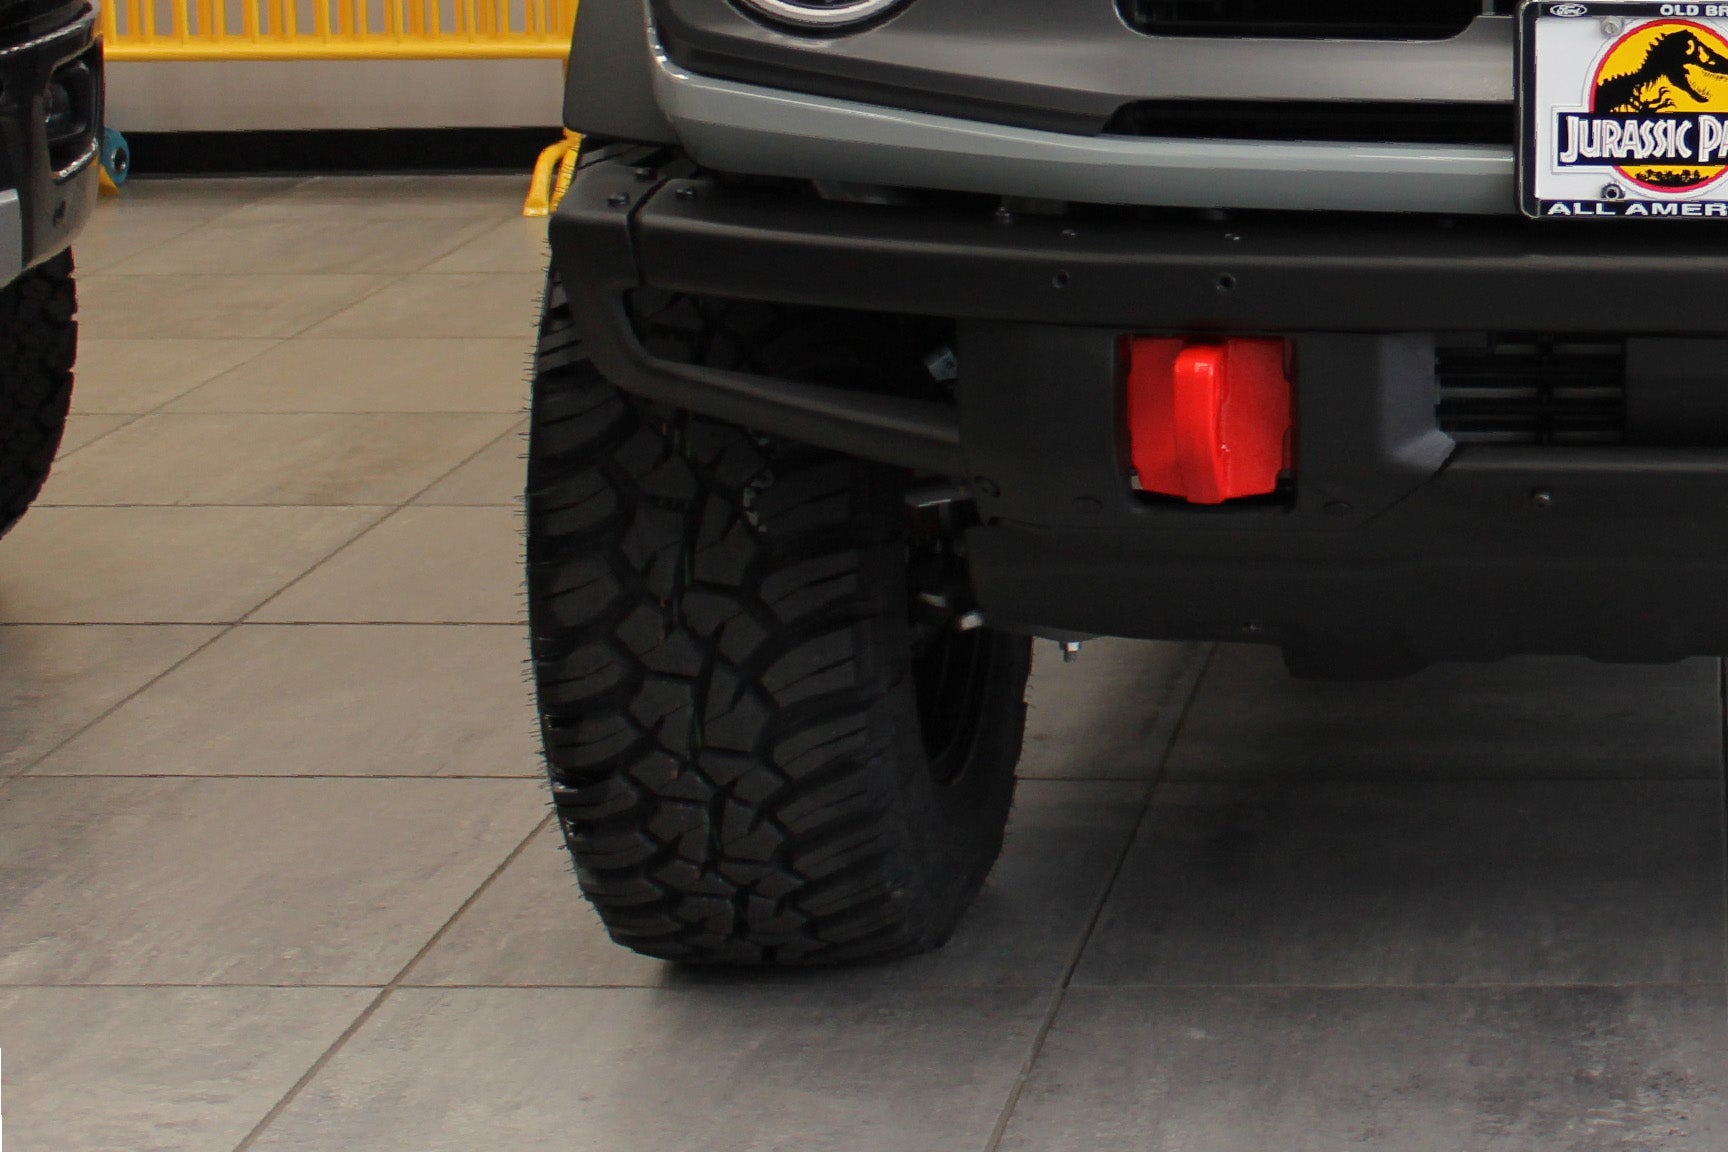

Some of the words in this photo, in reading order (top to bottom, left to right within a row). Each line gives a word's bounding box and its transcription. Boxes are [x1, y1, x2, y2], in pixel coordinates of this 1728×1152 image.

[1660, 4, 1699, 16] OLD
[1560, 114, 1691, 163] JURASSIC
[1547, 203, 1619, 216] ALL
